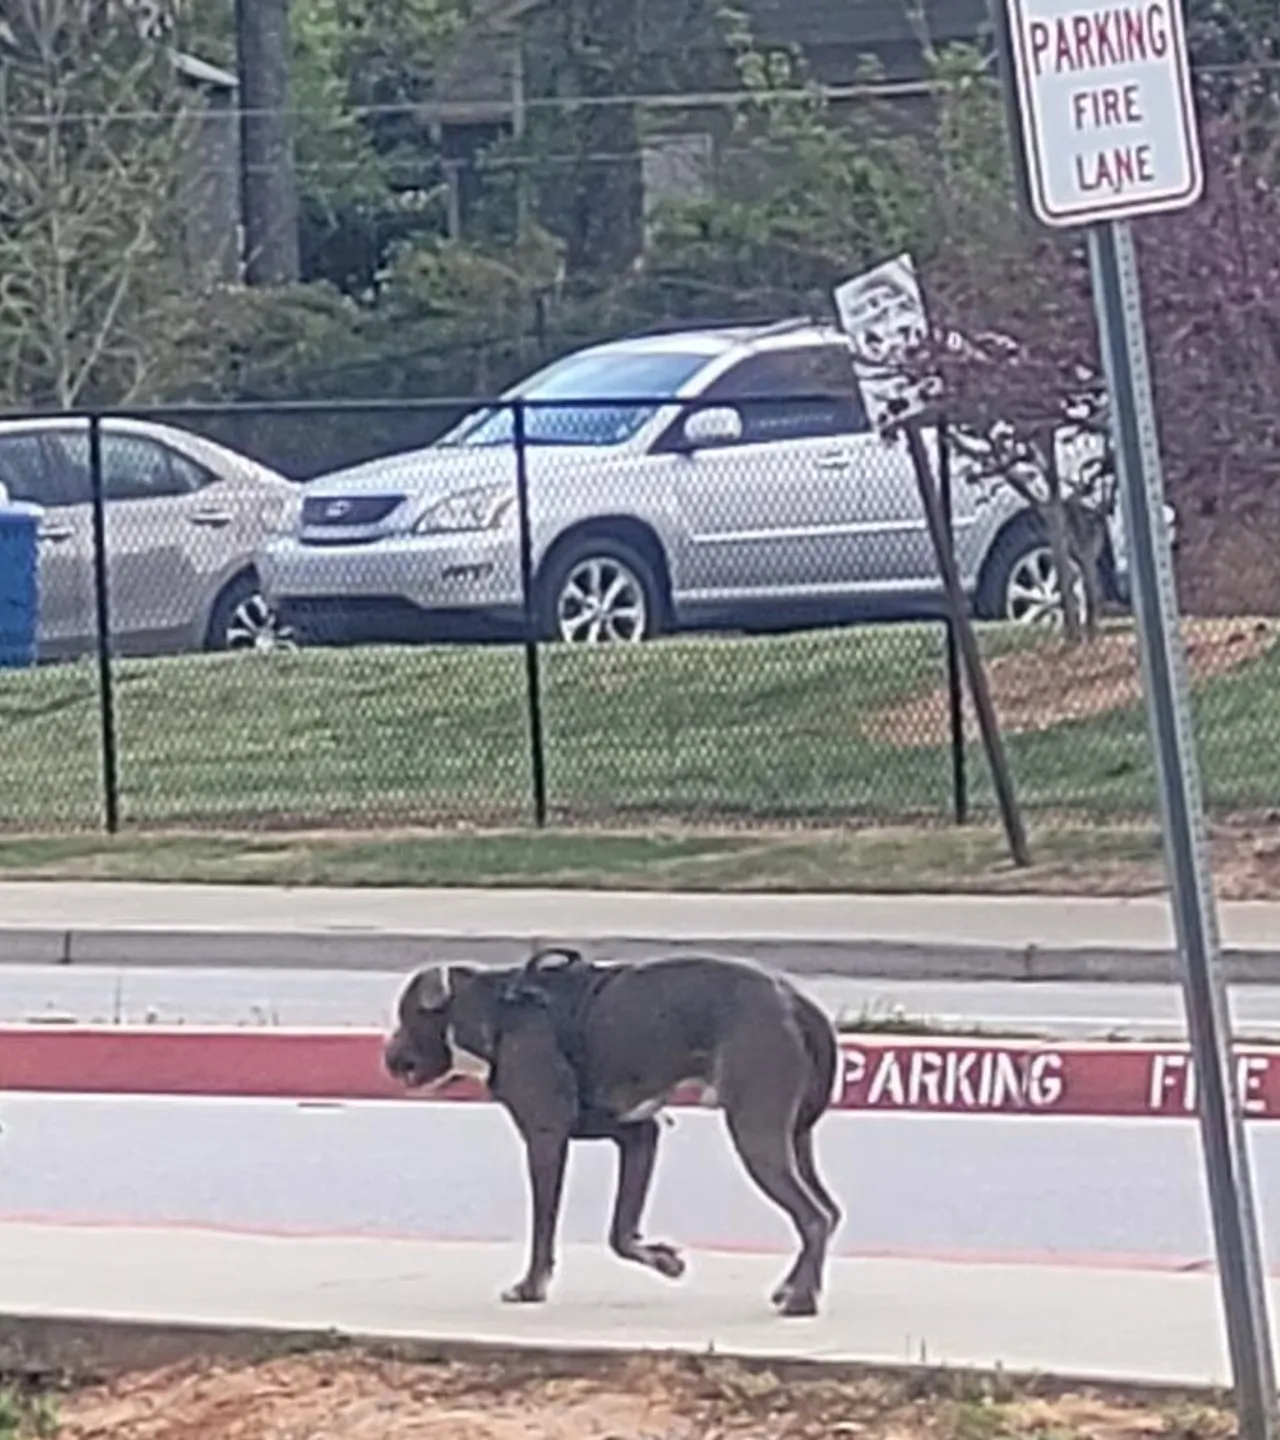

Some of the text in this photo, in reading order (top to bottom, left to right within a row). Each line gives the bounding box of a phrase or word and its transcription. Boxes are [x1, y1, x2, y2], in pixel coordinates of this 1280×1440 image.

[1029, 3, 1168, 76] PARKING
[1073, 85, 1142, 130] FIRE
[1076, 145, 1155, 191] LANE
[830, 1050, 1062, 1106] PARKING
[1149, 1055, 1269, 1112] FIE
